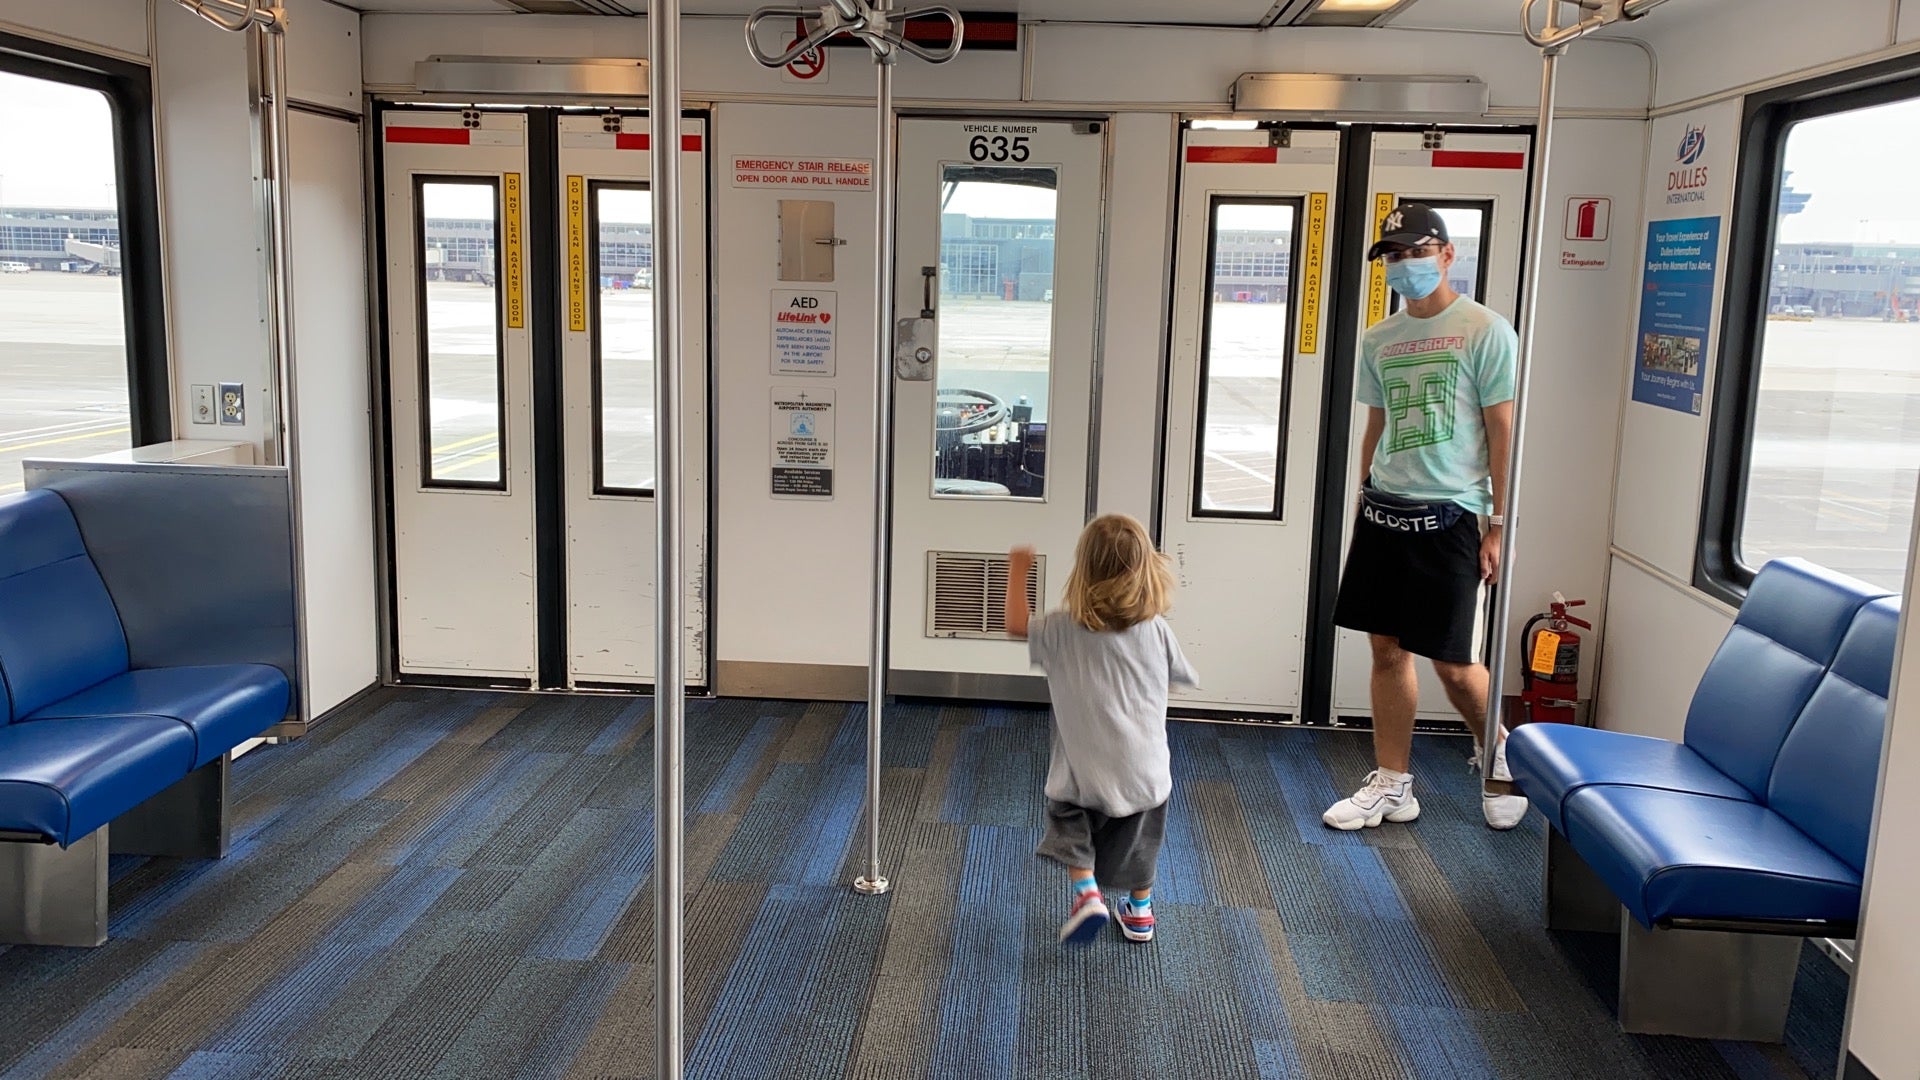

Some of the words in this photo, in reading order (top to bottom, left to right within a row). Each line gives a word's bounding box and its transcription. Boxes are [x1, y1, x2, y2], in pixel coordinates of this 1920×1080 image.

[970, 135, 1030, 162] 635
[736, 160, 794, 170] EMERGENCY
[798, 162, 823, 170] STAIR
[828, 162, 870, 172] RELEASE
[1668, 166, 1708, 190] DULLES
[509, 179, 516, 190] DO
[572, 182, 578, 193] DO
[1666, 191, 1705, 204] INTERNATIONAL
[1315, 200, 1322, 211] DO
[1380, 200, 1387, 211] DO
[1307, 275, 1316, 316] AGAINST
[1373, 275, 1382, 316] AGAINST
[790, 297, 818, 308] AED
[777, 312, 817, 324] LifeLink
[1380, 337, 1464, 358] MINECRAFT
